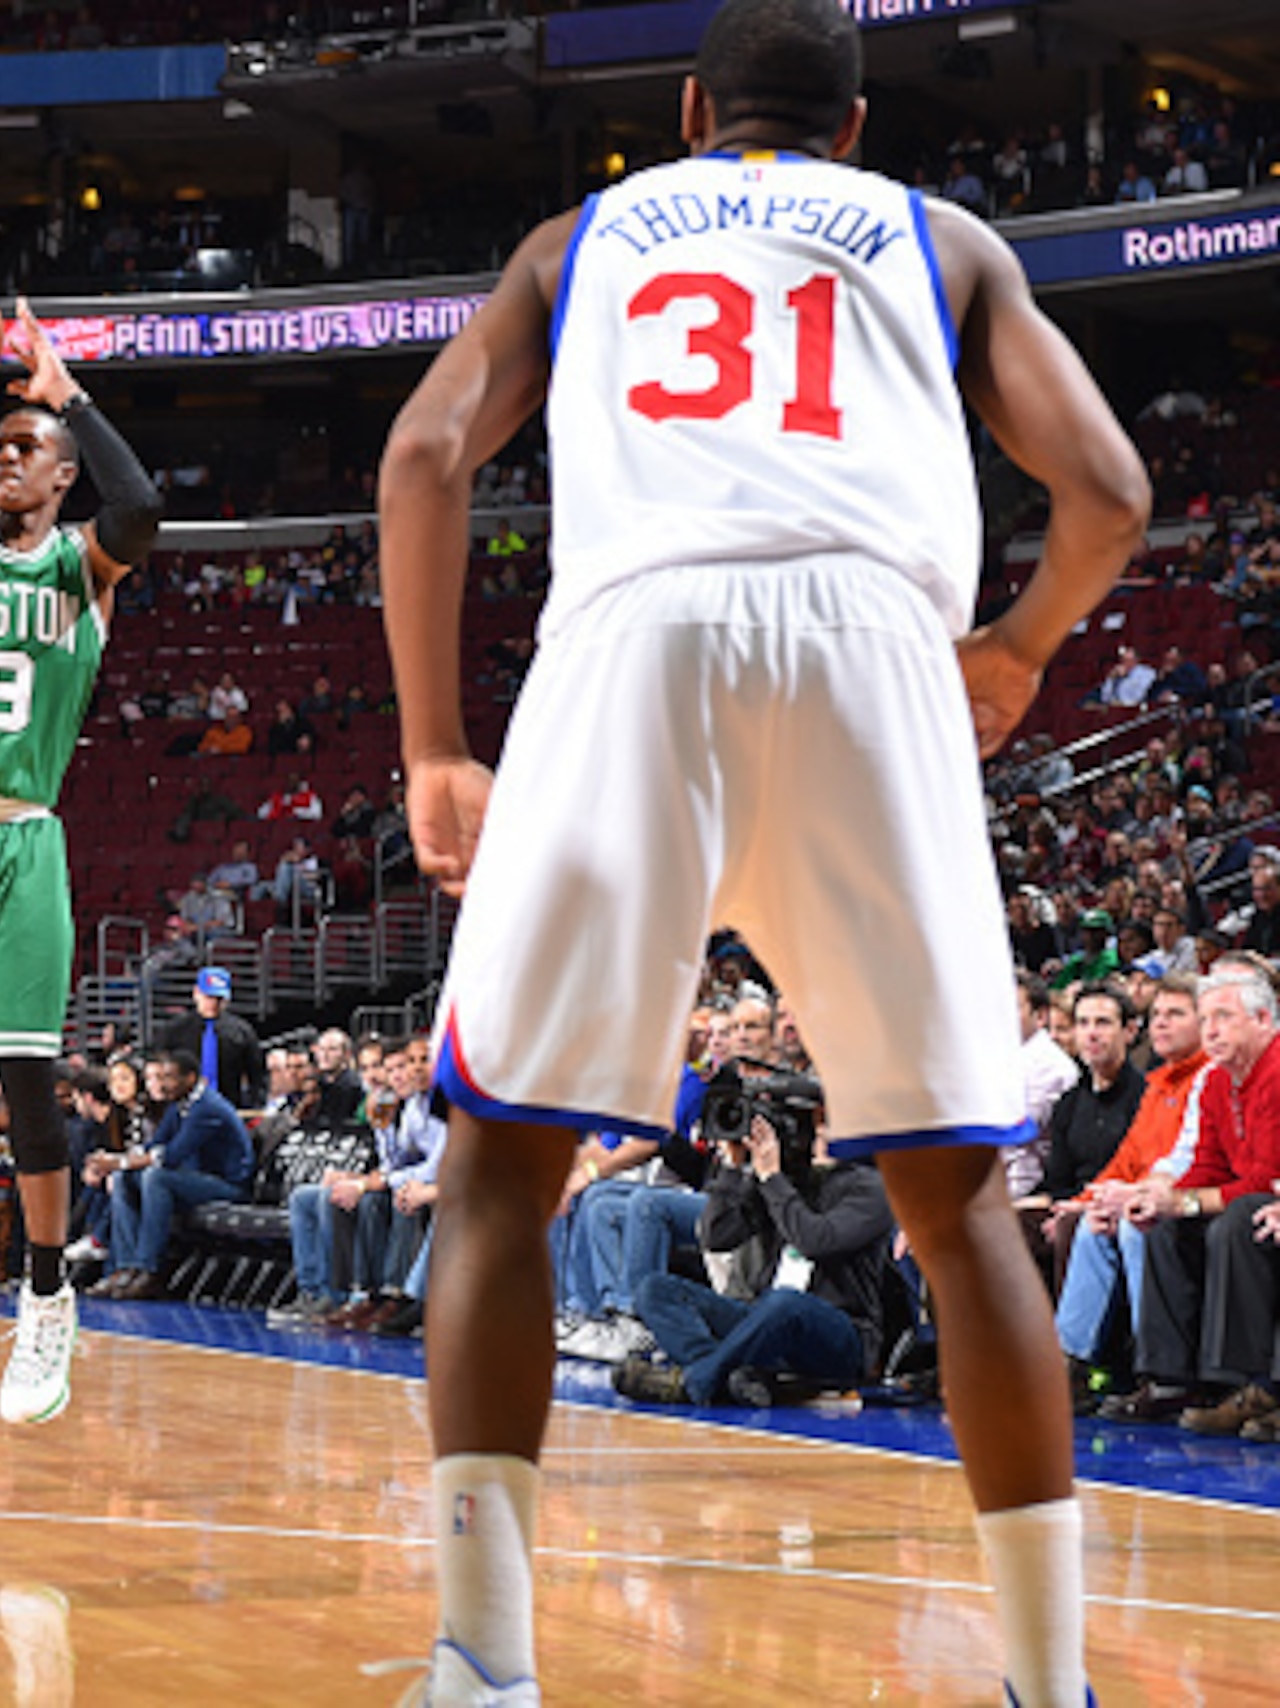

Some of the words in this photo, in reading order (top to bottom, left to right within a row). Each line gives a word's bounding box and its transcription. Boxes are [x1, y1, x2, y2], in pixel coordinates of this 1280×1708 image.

[596, 193, 908, 265] THOMPSON
[115, 320, 199, 355] PENN
[214, 316, 302, 352] STATE
[626, 271, 843, 442] 31
